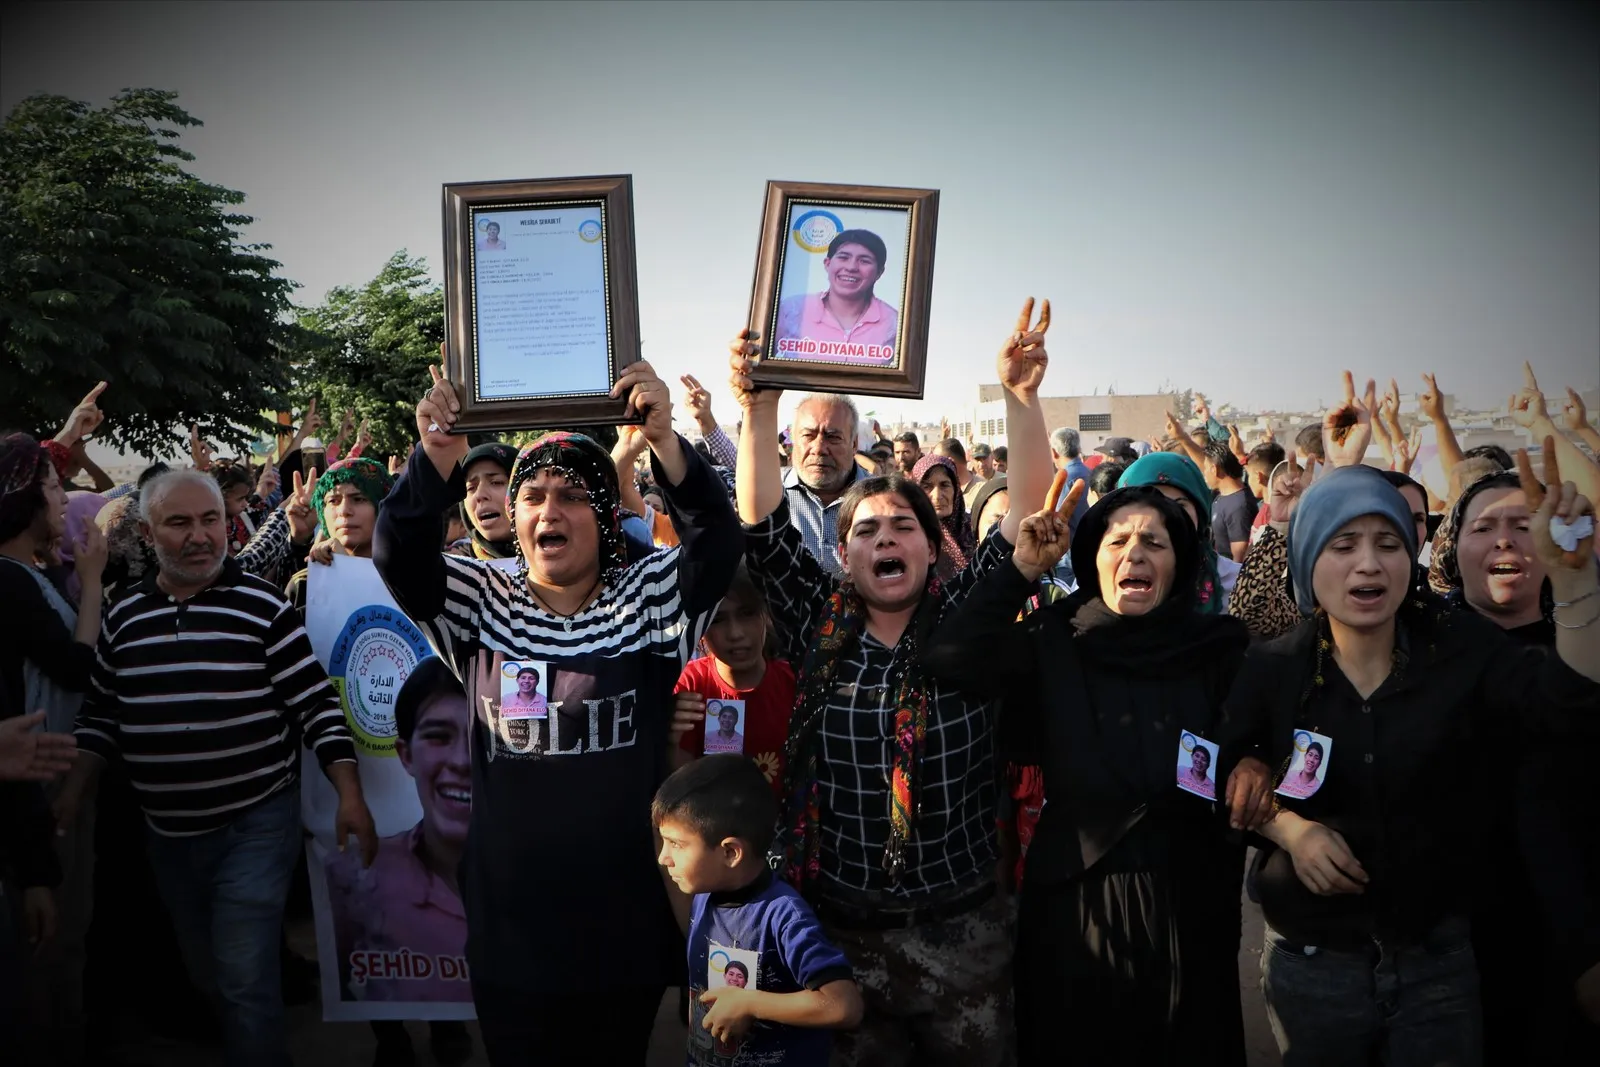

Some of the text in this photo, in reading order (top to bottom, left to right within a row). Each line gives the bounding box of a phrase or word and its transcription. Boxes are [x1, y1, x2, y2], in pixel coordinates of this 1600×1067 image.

[819, 342, 864, 357] DIYANA
[868, 345, 893, 359] ELO
[350, 947, 467, 984] ŞEHÎD DI
